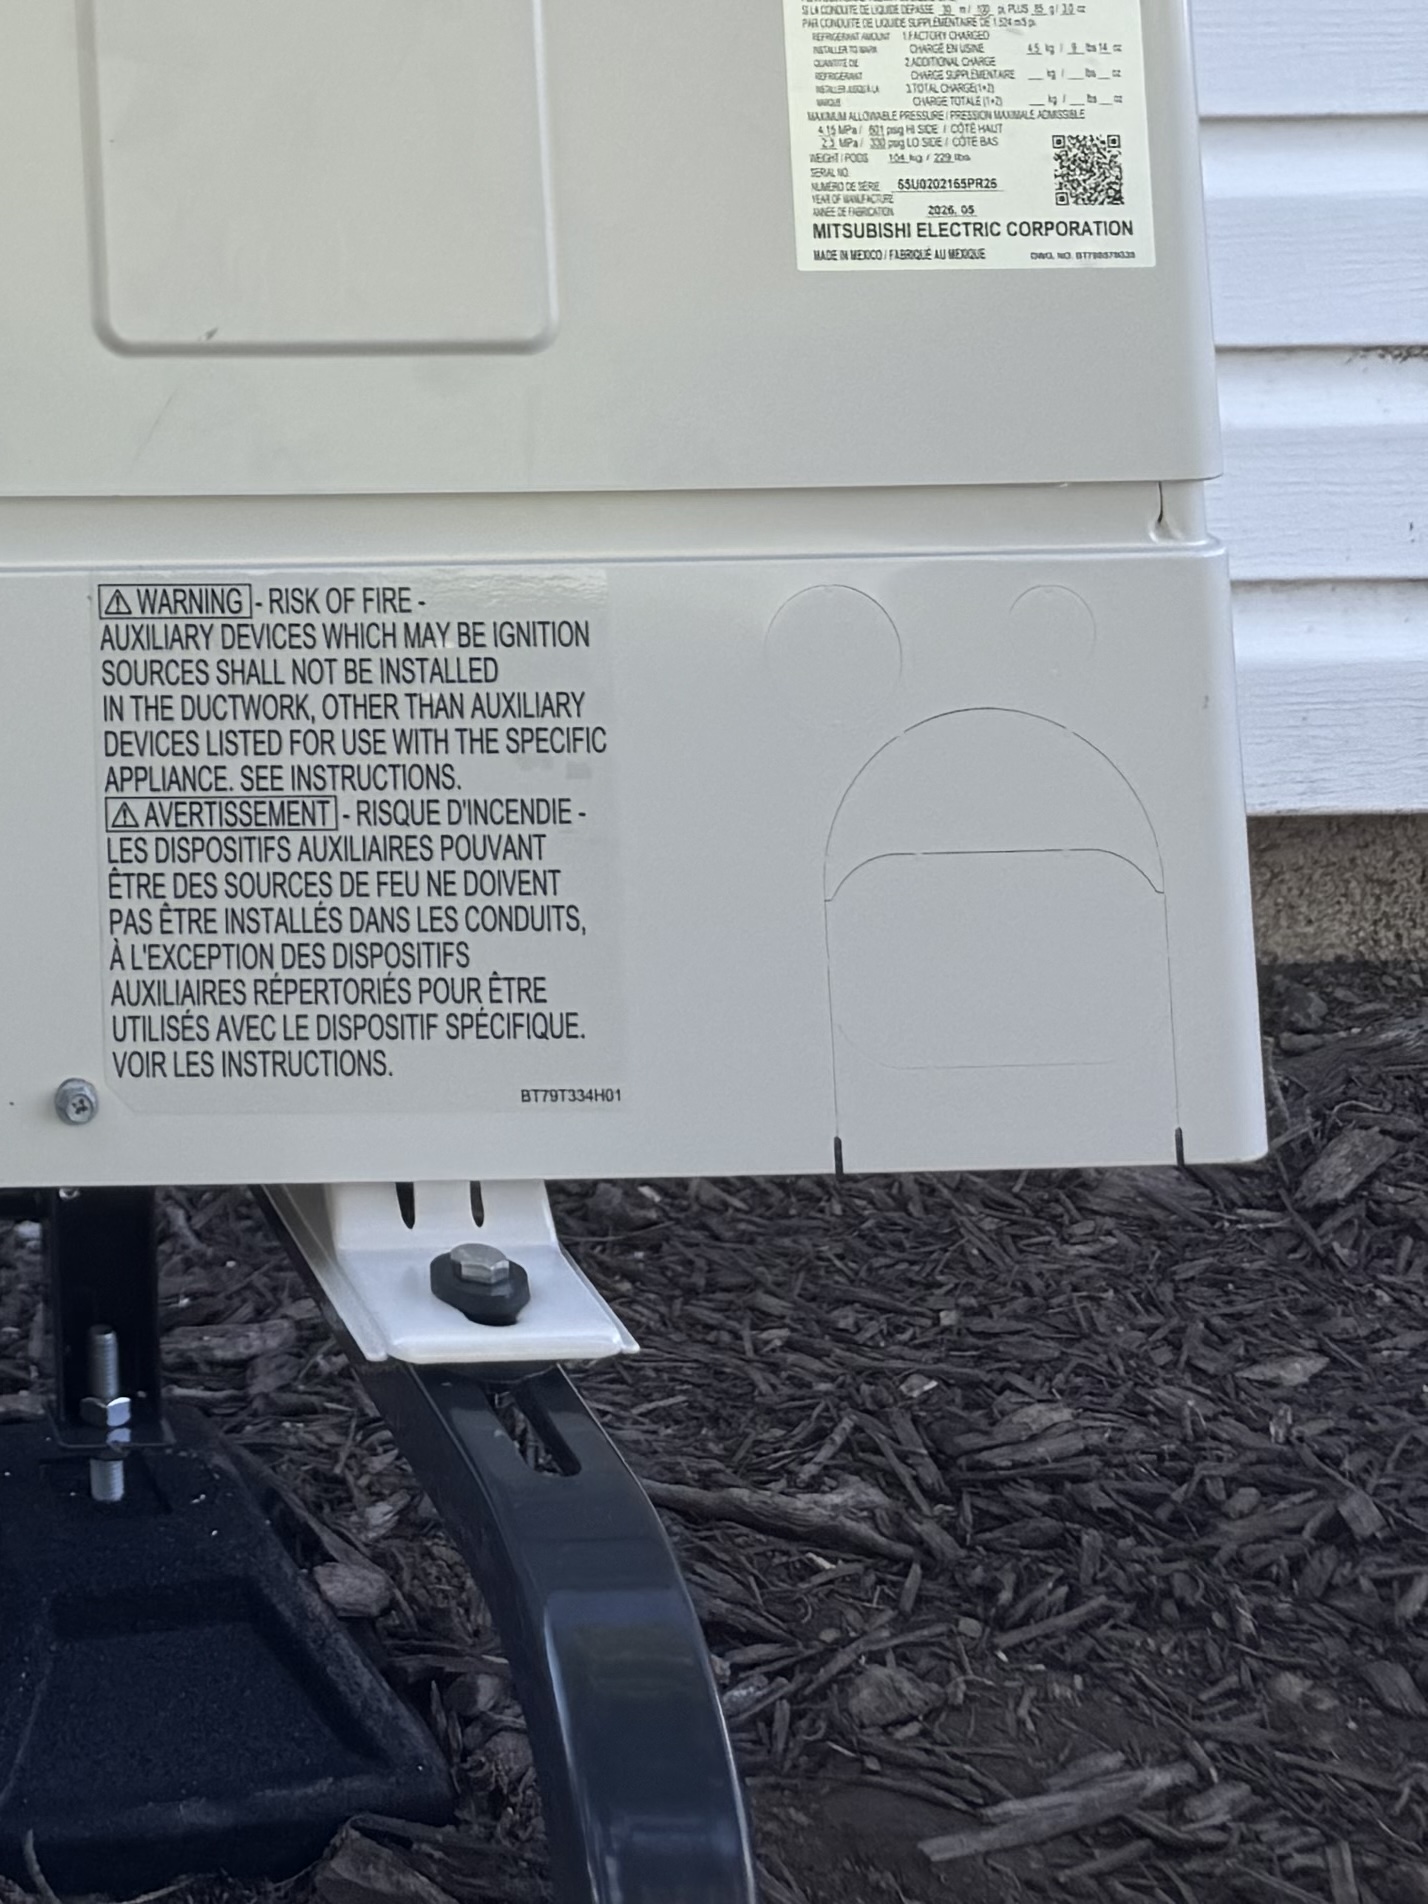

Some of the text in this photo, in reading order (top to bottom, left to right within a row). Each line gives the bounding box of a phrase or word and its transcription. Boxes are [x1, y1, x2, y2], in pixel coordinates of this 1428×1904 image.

[812, 220, 1134, 239] MITSUBISHI ELECTRIC CORPORATION
[813, 249, 838, 261] MADE
[850, 249, 882, 261] MEXICO
[934, 248, 945, 260] AU
[136, 587, 412, 615] WARNING RISK OF FIRE
[100, 620, 590, 651] AUXILIARY DEVICES WHICH MAY BE IGNITION
[102, 656, 498, 687] SOURCES SHALL NOT BE INSTALLED
[103, 691, 585, 724] IN THE DUCTWORK, OTHER THAN AUXILIARY
[104, 726, 607, 757] DEVICES LISTED FOR USE WITH THE SPECIFIC
[104, 763, 461, 793] APPLIANCE. SEE INSTRUCTIONS.
[144, 798, 572, 828] AVERTISSEMENT RISQUE D'INCENDIE
[107, 833, 547, 864] LES DISPOSITIFS AUXILIAIRES POUVANT
[108, 866, 561, 900] ÊTRE DES SOURCES DE FEU NE DOIVENT
[109, 900, 586, 936] PAS ÊTRE INSTALLÉS DANS LES CONDUITS,
[109, 937, 470, 971] À L'EXCEPTION DES DISPOSITIFS
[111, 971, 547, 1007] AUXILIAIRES RÉPERTORIÉS POUR ÊTRE
[112, 1006, 585, 1043] UTILISÉS AVEC LE DISPOSITIF SPÉCIFIQUE.
[112, 1049, 393, 1078] VOIR LES INSTRUCTIONS.
[521, 1088, 621, 1103] BT79T334H01
